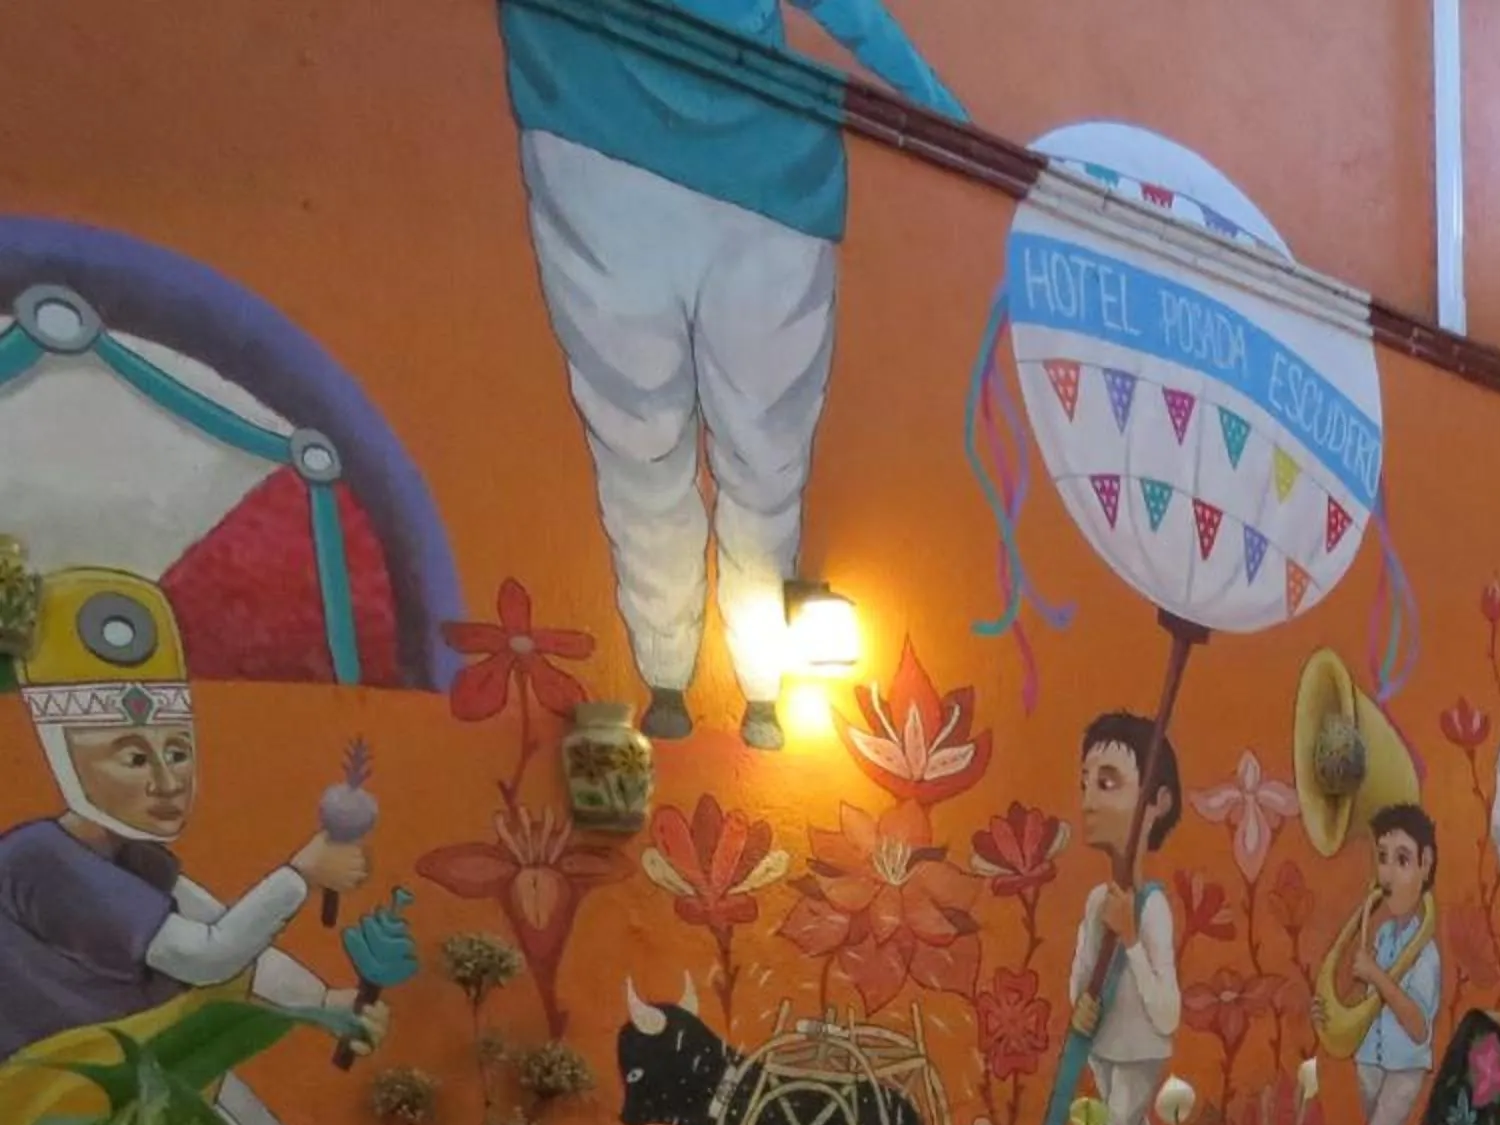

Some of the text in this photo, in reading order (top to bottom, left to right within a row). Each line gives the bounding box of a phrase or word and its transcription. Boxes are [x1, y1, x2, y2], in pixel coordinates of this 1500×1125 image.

[1023, 247, 1382, 500] HOTEL POSADA ESCUDERO
